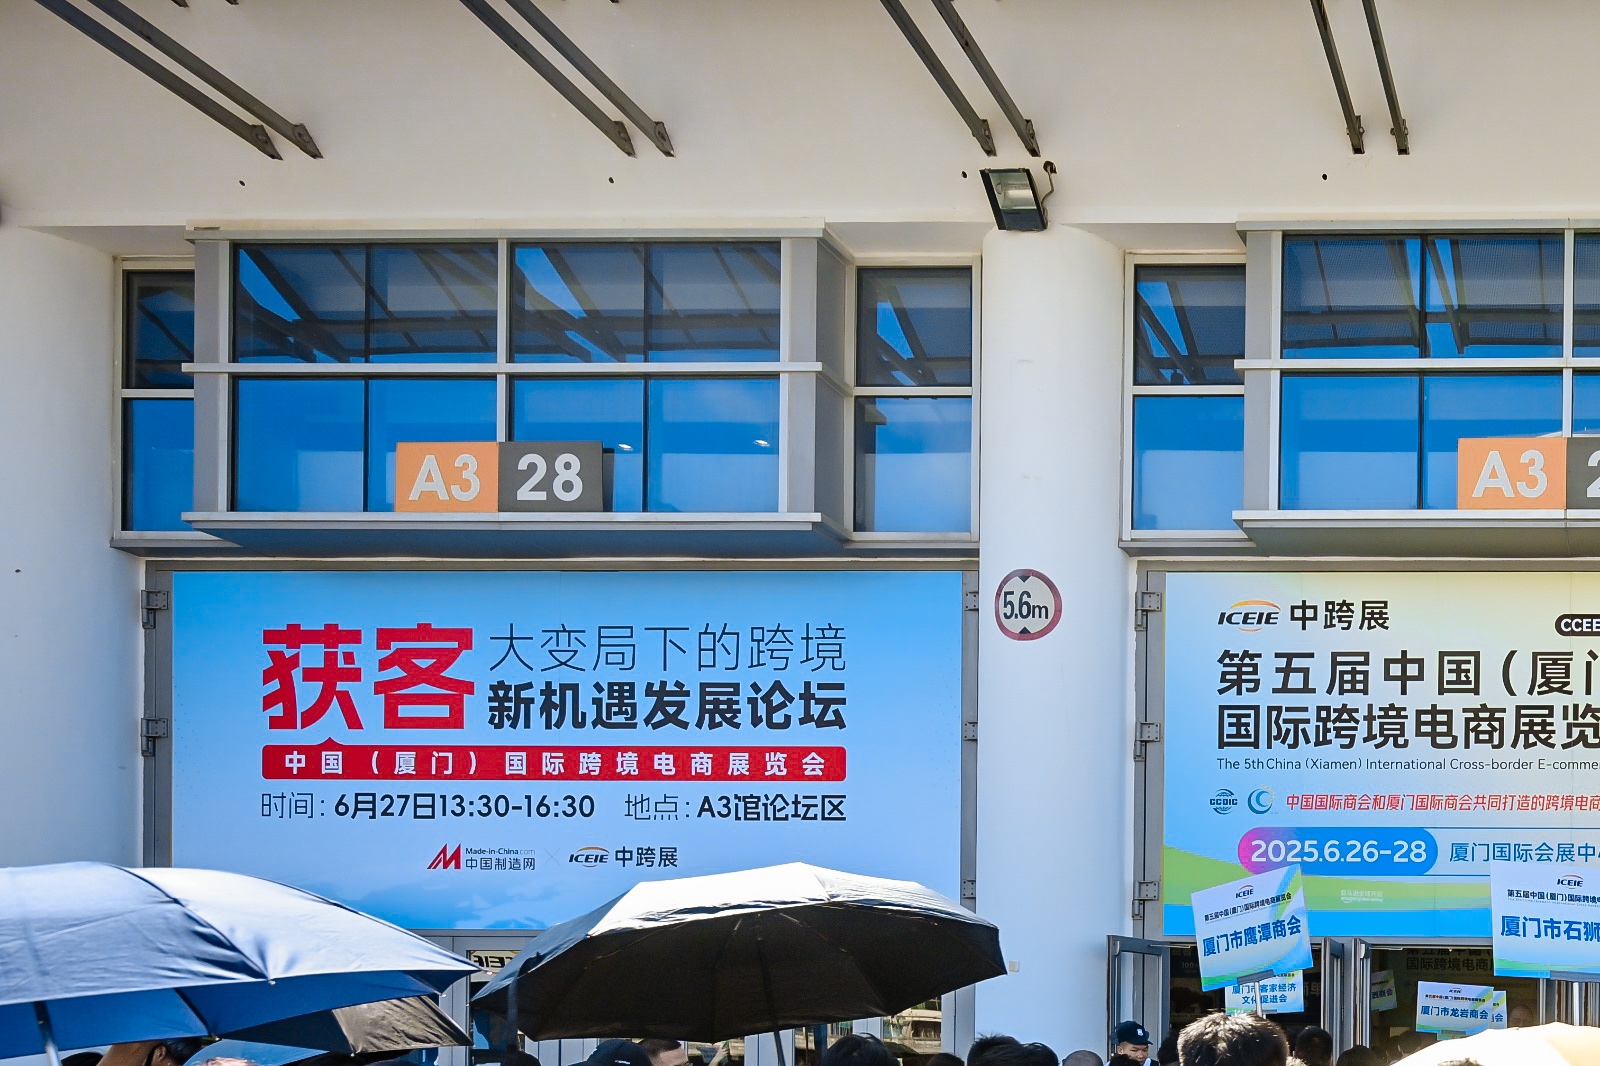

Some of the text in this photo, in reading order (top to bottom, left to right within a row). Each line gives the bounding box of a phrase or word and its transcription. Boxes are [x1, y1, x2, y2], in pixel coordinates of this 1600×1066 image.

[408, 453, 583, 501] A3 28
[1472, 450, 1547, 498] A3
[1003, 590, 1049, 620] 5.6m
[1290, 599, 1390, 631] 中跨展
[1217, 611, 1280, 626] ICEIE
[489, 623, 847, 672] 大变局下的跨境
[262, 623, 475, 730] 获客
[488, 680, 847, 730] 新机遇发展论坛
[285, 751, 825, 776] 中国（厦门）国际跨境电商展览会
[1217, 758, 1240, 770] The
[1244, 758, 1264, 770] 5th
[1266, 758, 1301, 770] China
[1305, 758, 1362, 771] (Xiamen)
[1366, 758, 1446, 770] International
[1450, 758, 1534, 771] Cross-border
[568, 853, 609, 864] ICEIE
[615, 846, 678, 868] 中跨展
[1251, 839, 1427, 863] 2025.6.26-28
[465, 857, 536, 871] 中国制造网
[1203, 914, 1301, 957] 厦门市鹰潭商会
[1406, 957, 1494, 971] 国际跨境电商
[1420, 1005, 1488, 1020] 厦门市龙岩商会
